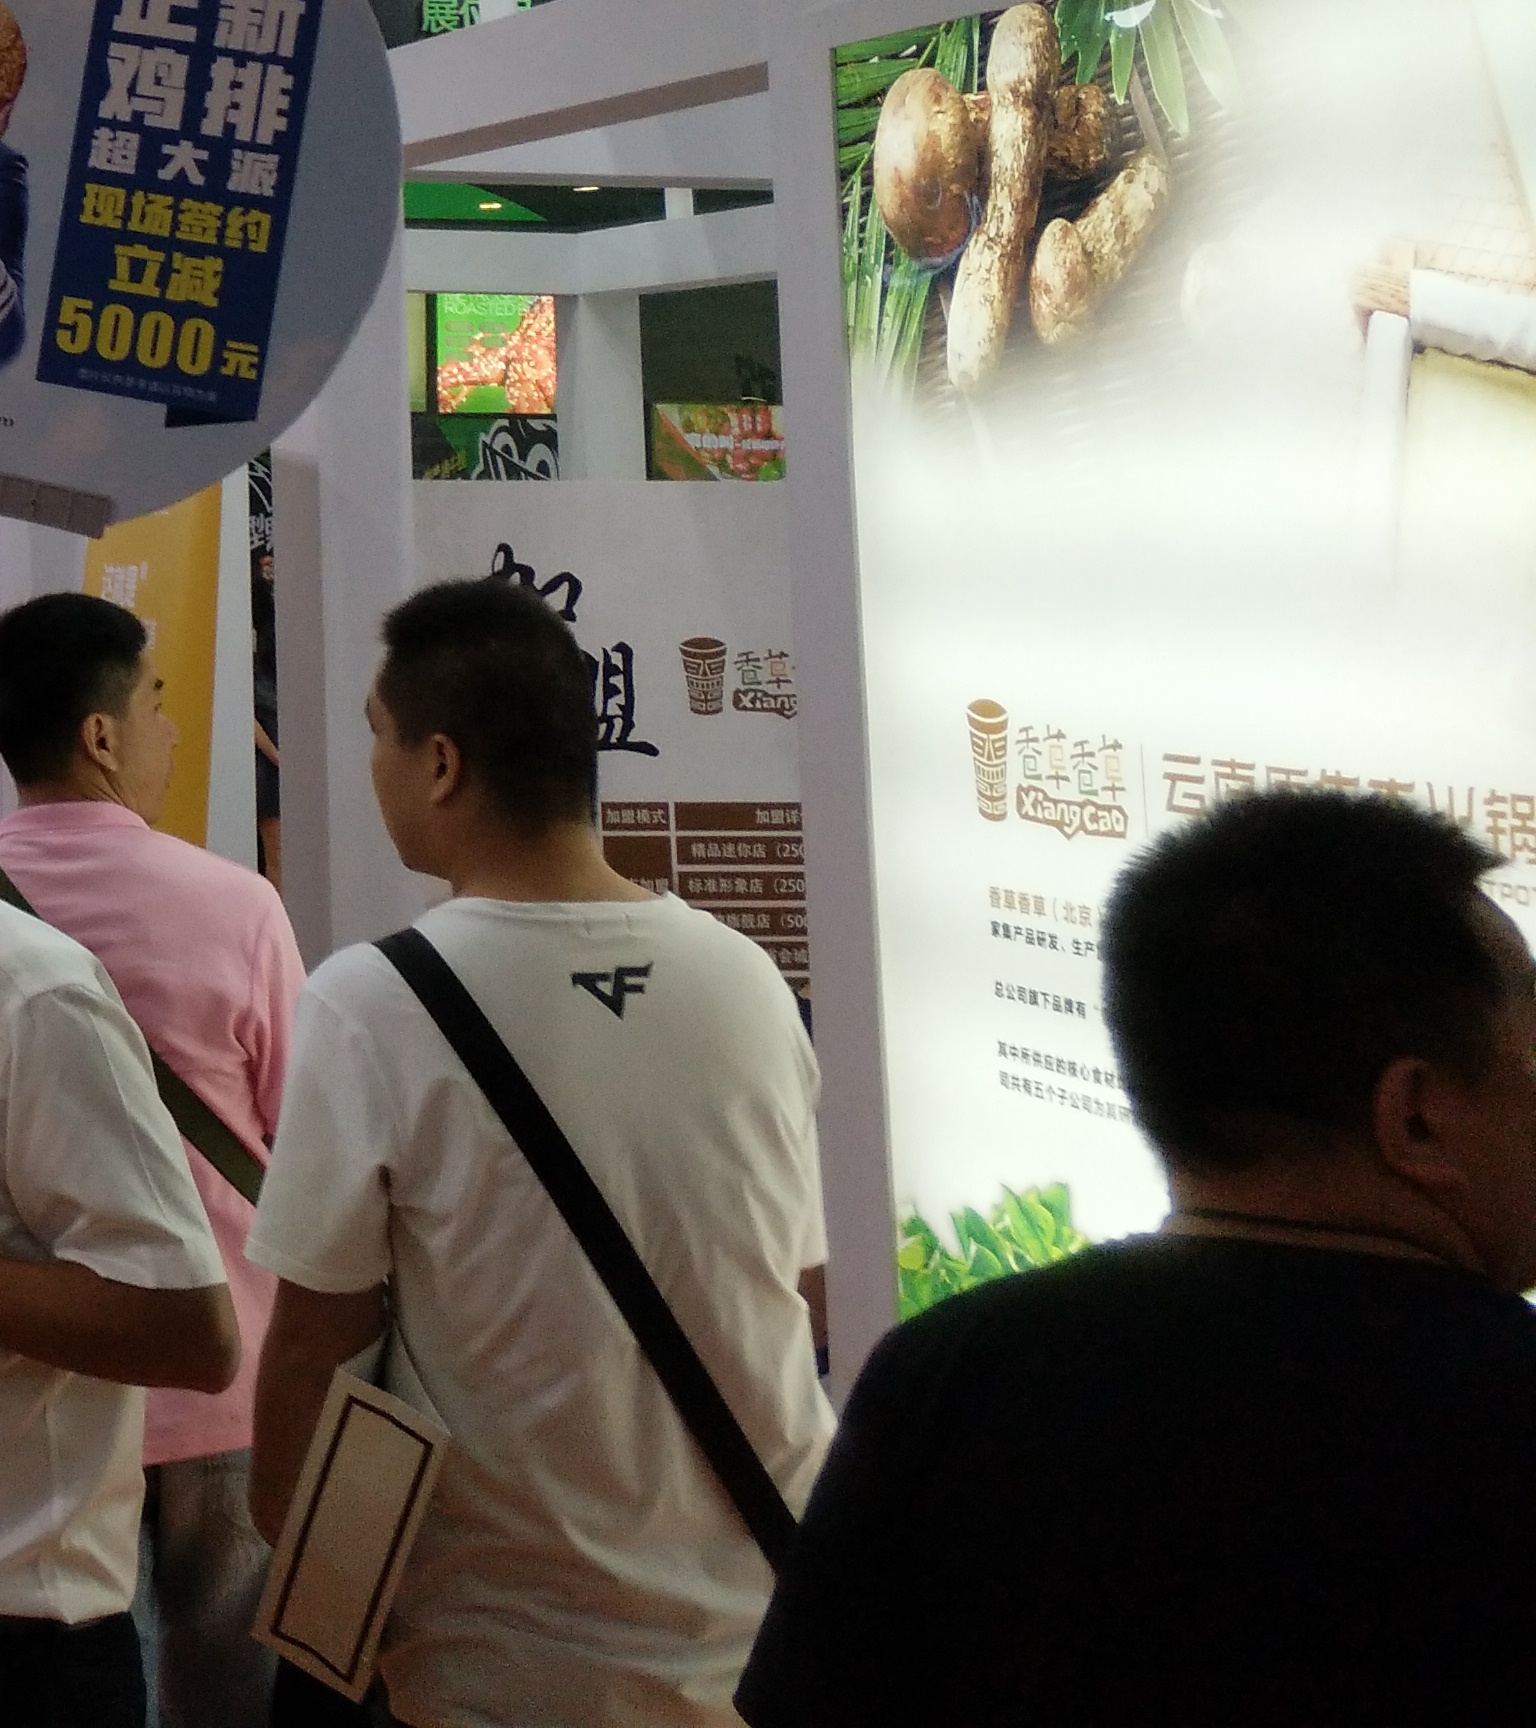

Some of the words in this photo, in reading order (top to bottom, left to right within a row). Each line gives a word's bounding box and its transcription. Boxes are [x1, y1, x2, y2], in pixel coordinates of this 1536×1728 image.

[97, 41, 295, 146] 鸡排
[87, 126, 280, 198] 超大派
[79, 182, 272, 254] 现场签约
[107, 243, 225, 308] 立减
[55, 295, 260, 380] 5000元
[606, 808, 666, 824] 加盟模式
